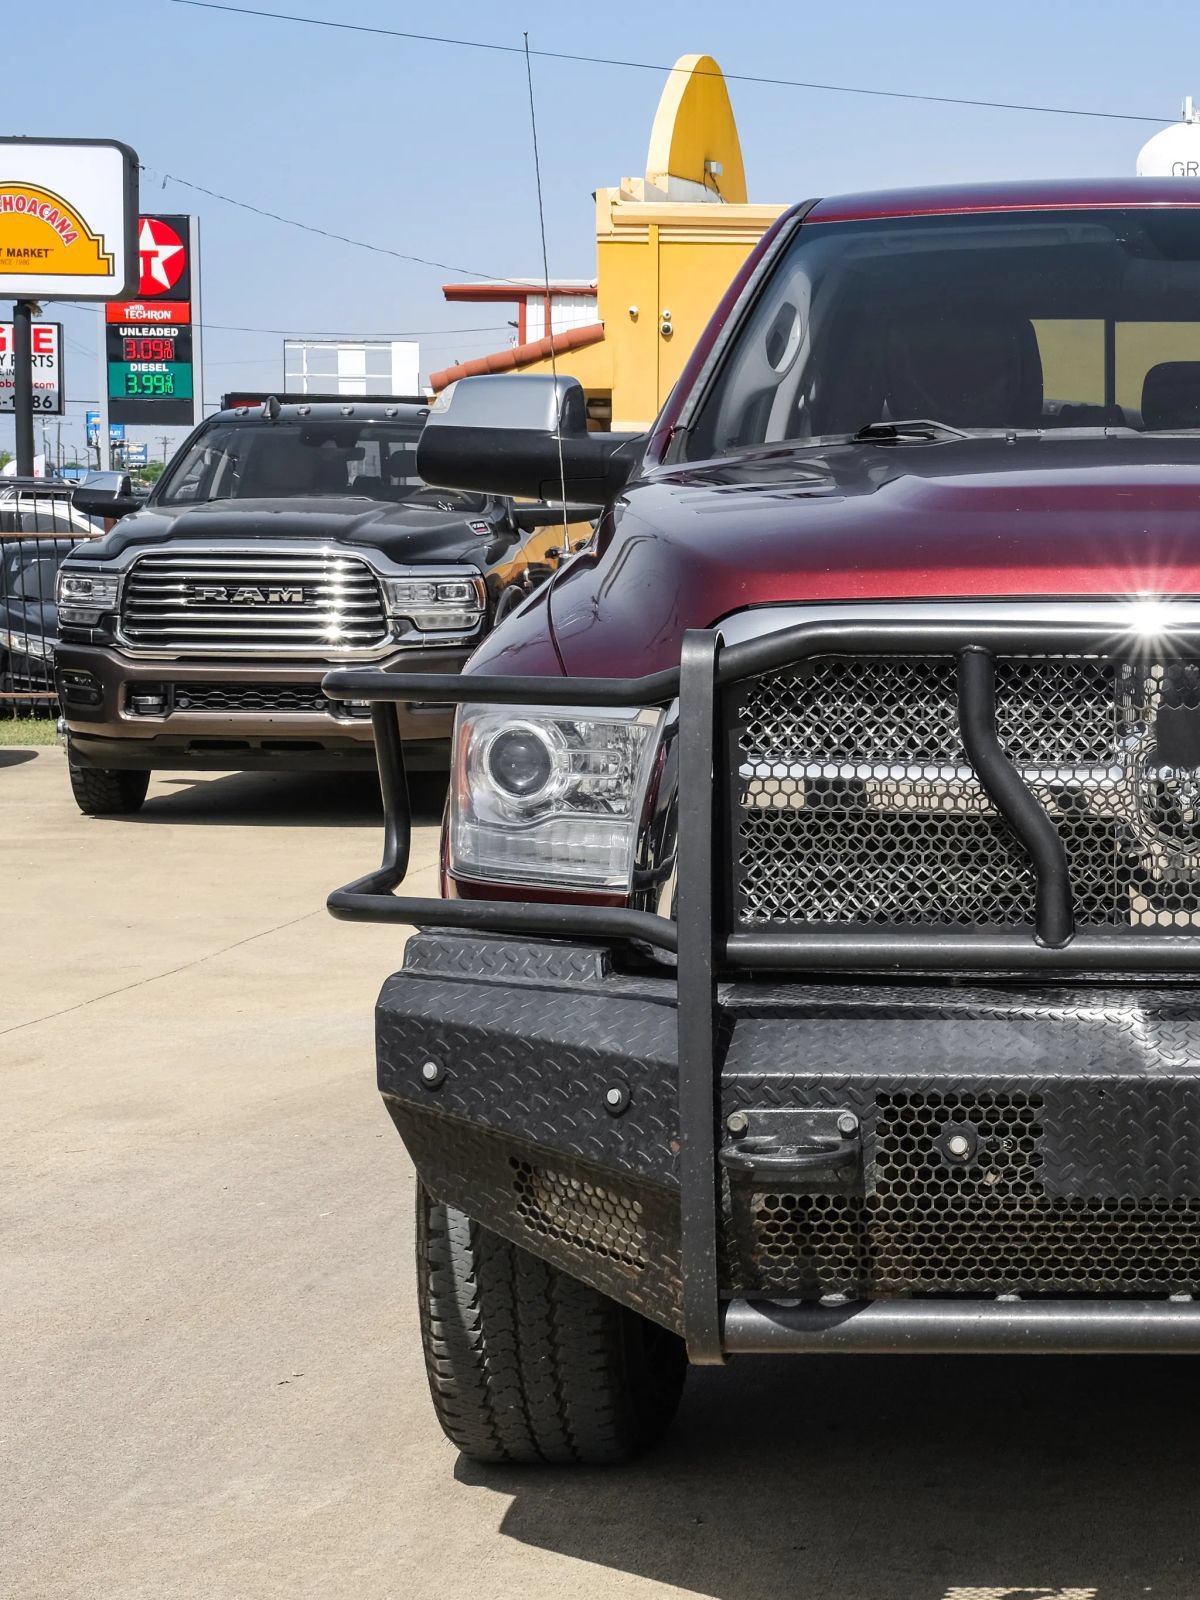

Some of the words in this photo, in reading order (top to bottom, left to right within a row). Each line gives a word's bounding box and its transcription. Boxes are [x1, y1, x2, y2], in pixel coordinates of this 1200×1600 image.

[0, 195, 79, 245] HOACANA
[6, 248, 49, 258] MARKET
[124, 308, 172, 320] TECHRON
[119, 327, 179, 337] UNLEADED
[126, 340, 163, 359] 3.09
[130, 363, 169, 372] DIESEL
[127, 374, 164, 394] 3.99
[194, 586, 303, 602] RAM
